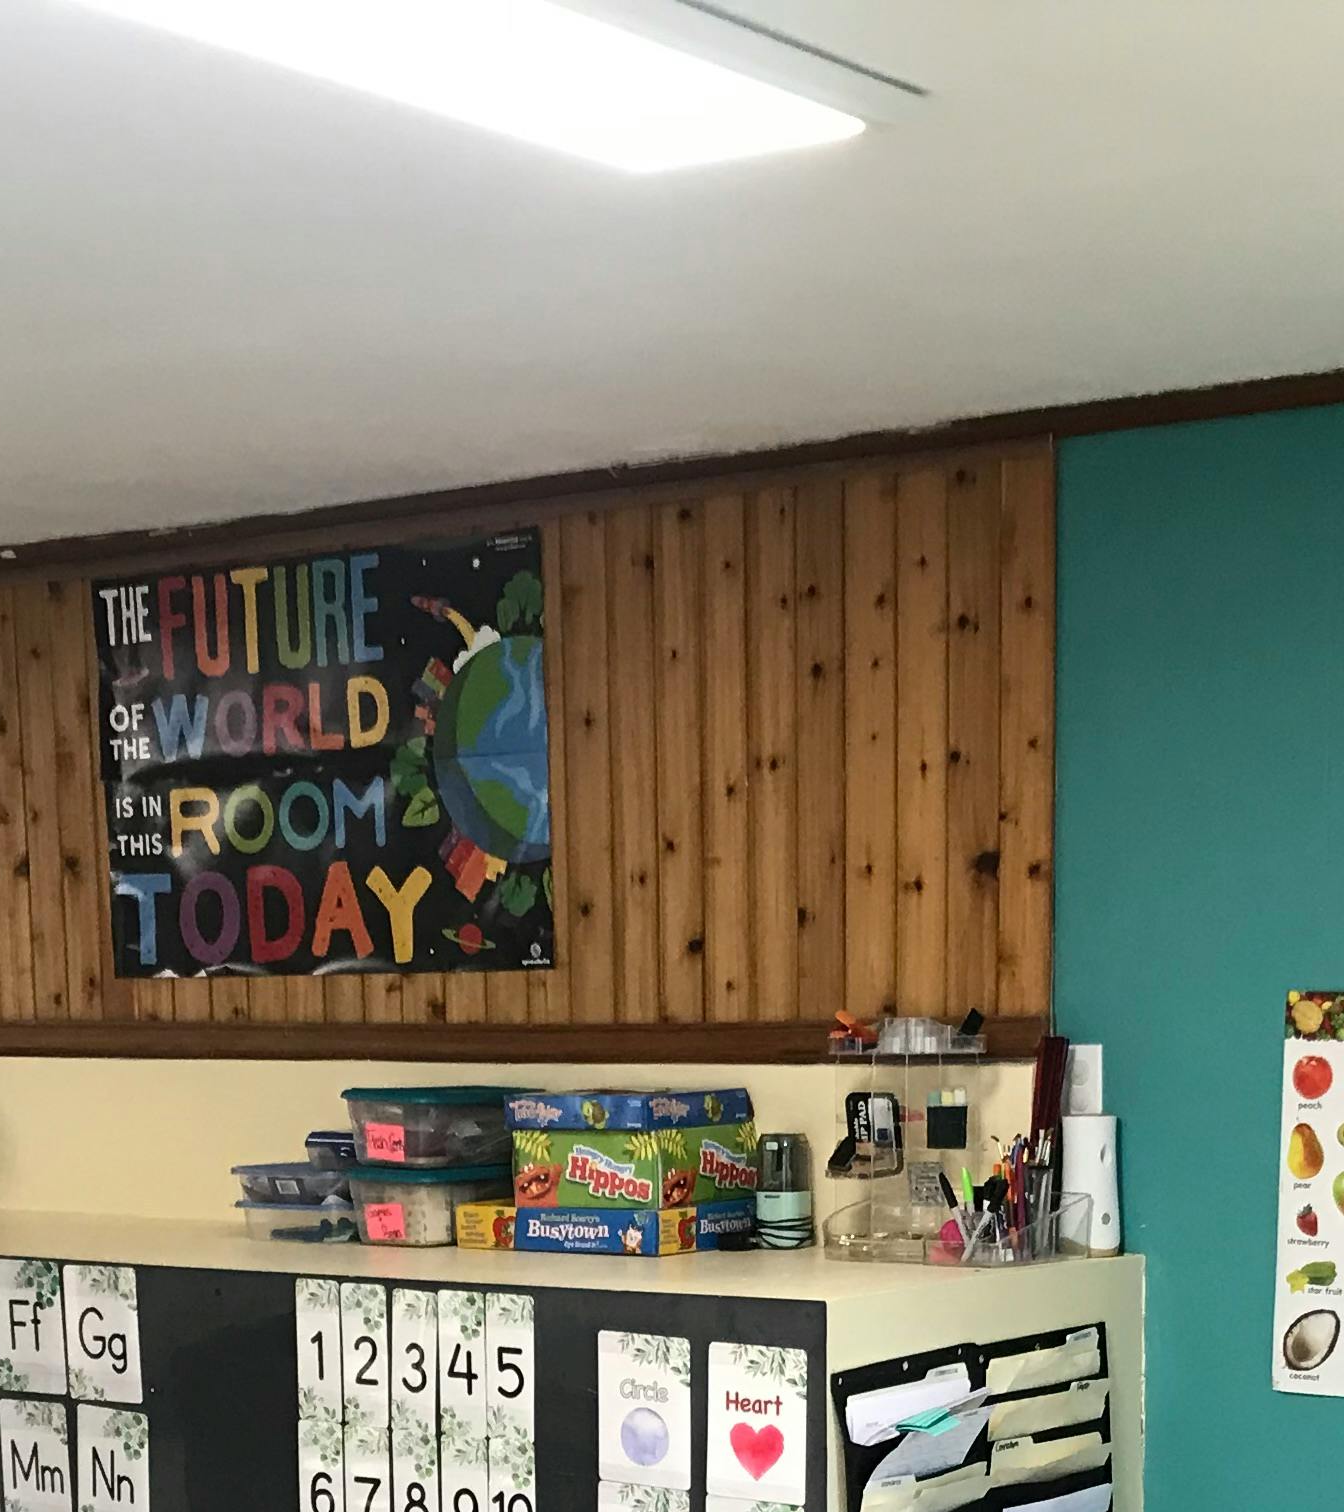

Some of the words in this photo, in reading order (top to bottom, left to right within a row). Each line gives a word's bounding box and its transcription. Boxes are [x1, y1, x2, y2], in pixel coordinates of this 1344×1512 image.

[99, 585, 152, 646] THE
[158, 553, 384, 680] FUTURE
[109, 704, 145, 732] OF
[109, 737, 151, 761] THE
[152, 676, 390, 763] WORLD
[115, 798, 134, 819] IS
[141, 794, 163, 818] IN
[116, 835, 163, 857] THIS
[169, 776, 387, 858] ROOM
[114, 861, 433, 967] TODAY
[1298, 1101, 1323, 1112] peach
[568, 1155, 651, 1200] Hippos
[1293, 1181, 1311, 1190] pear
[527, 1219, 609, 1240] Busytown
[1287, 1237, 1330, 1248] strawberry
[9, 1300, 40, 1351] Ff
[79, 1307, 127, 1373] Gg
[311, 1331, 324, 1380] 1
[354, 1336, 378, 1386] 2
[402, 1343, 427, 1393] 3
[448, 1344, 478, 1395] 4
[497, 1347, 524, 1398] 5
[1289, 1372, 1320, 1382] coconut
[619, 1377, 669, 1403] Circle
[726, 1391, 783, 1416] Heart
[11, 1439, 64, 1495] Mm
[92, 1446, 134, 1504] Nn
